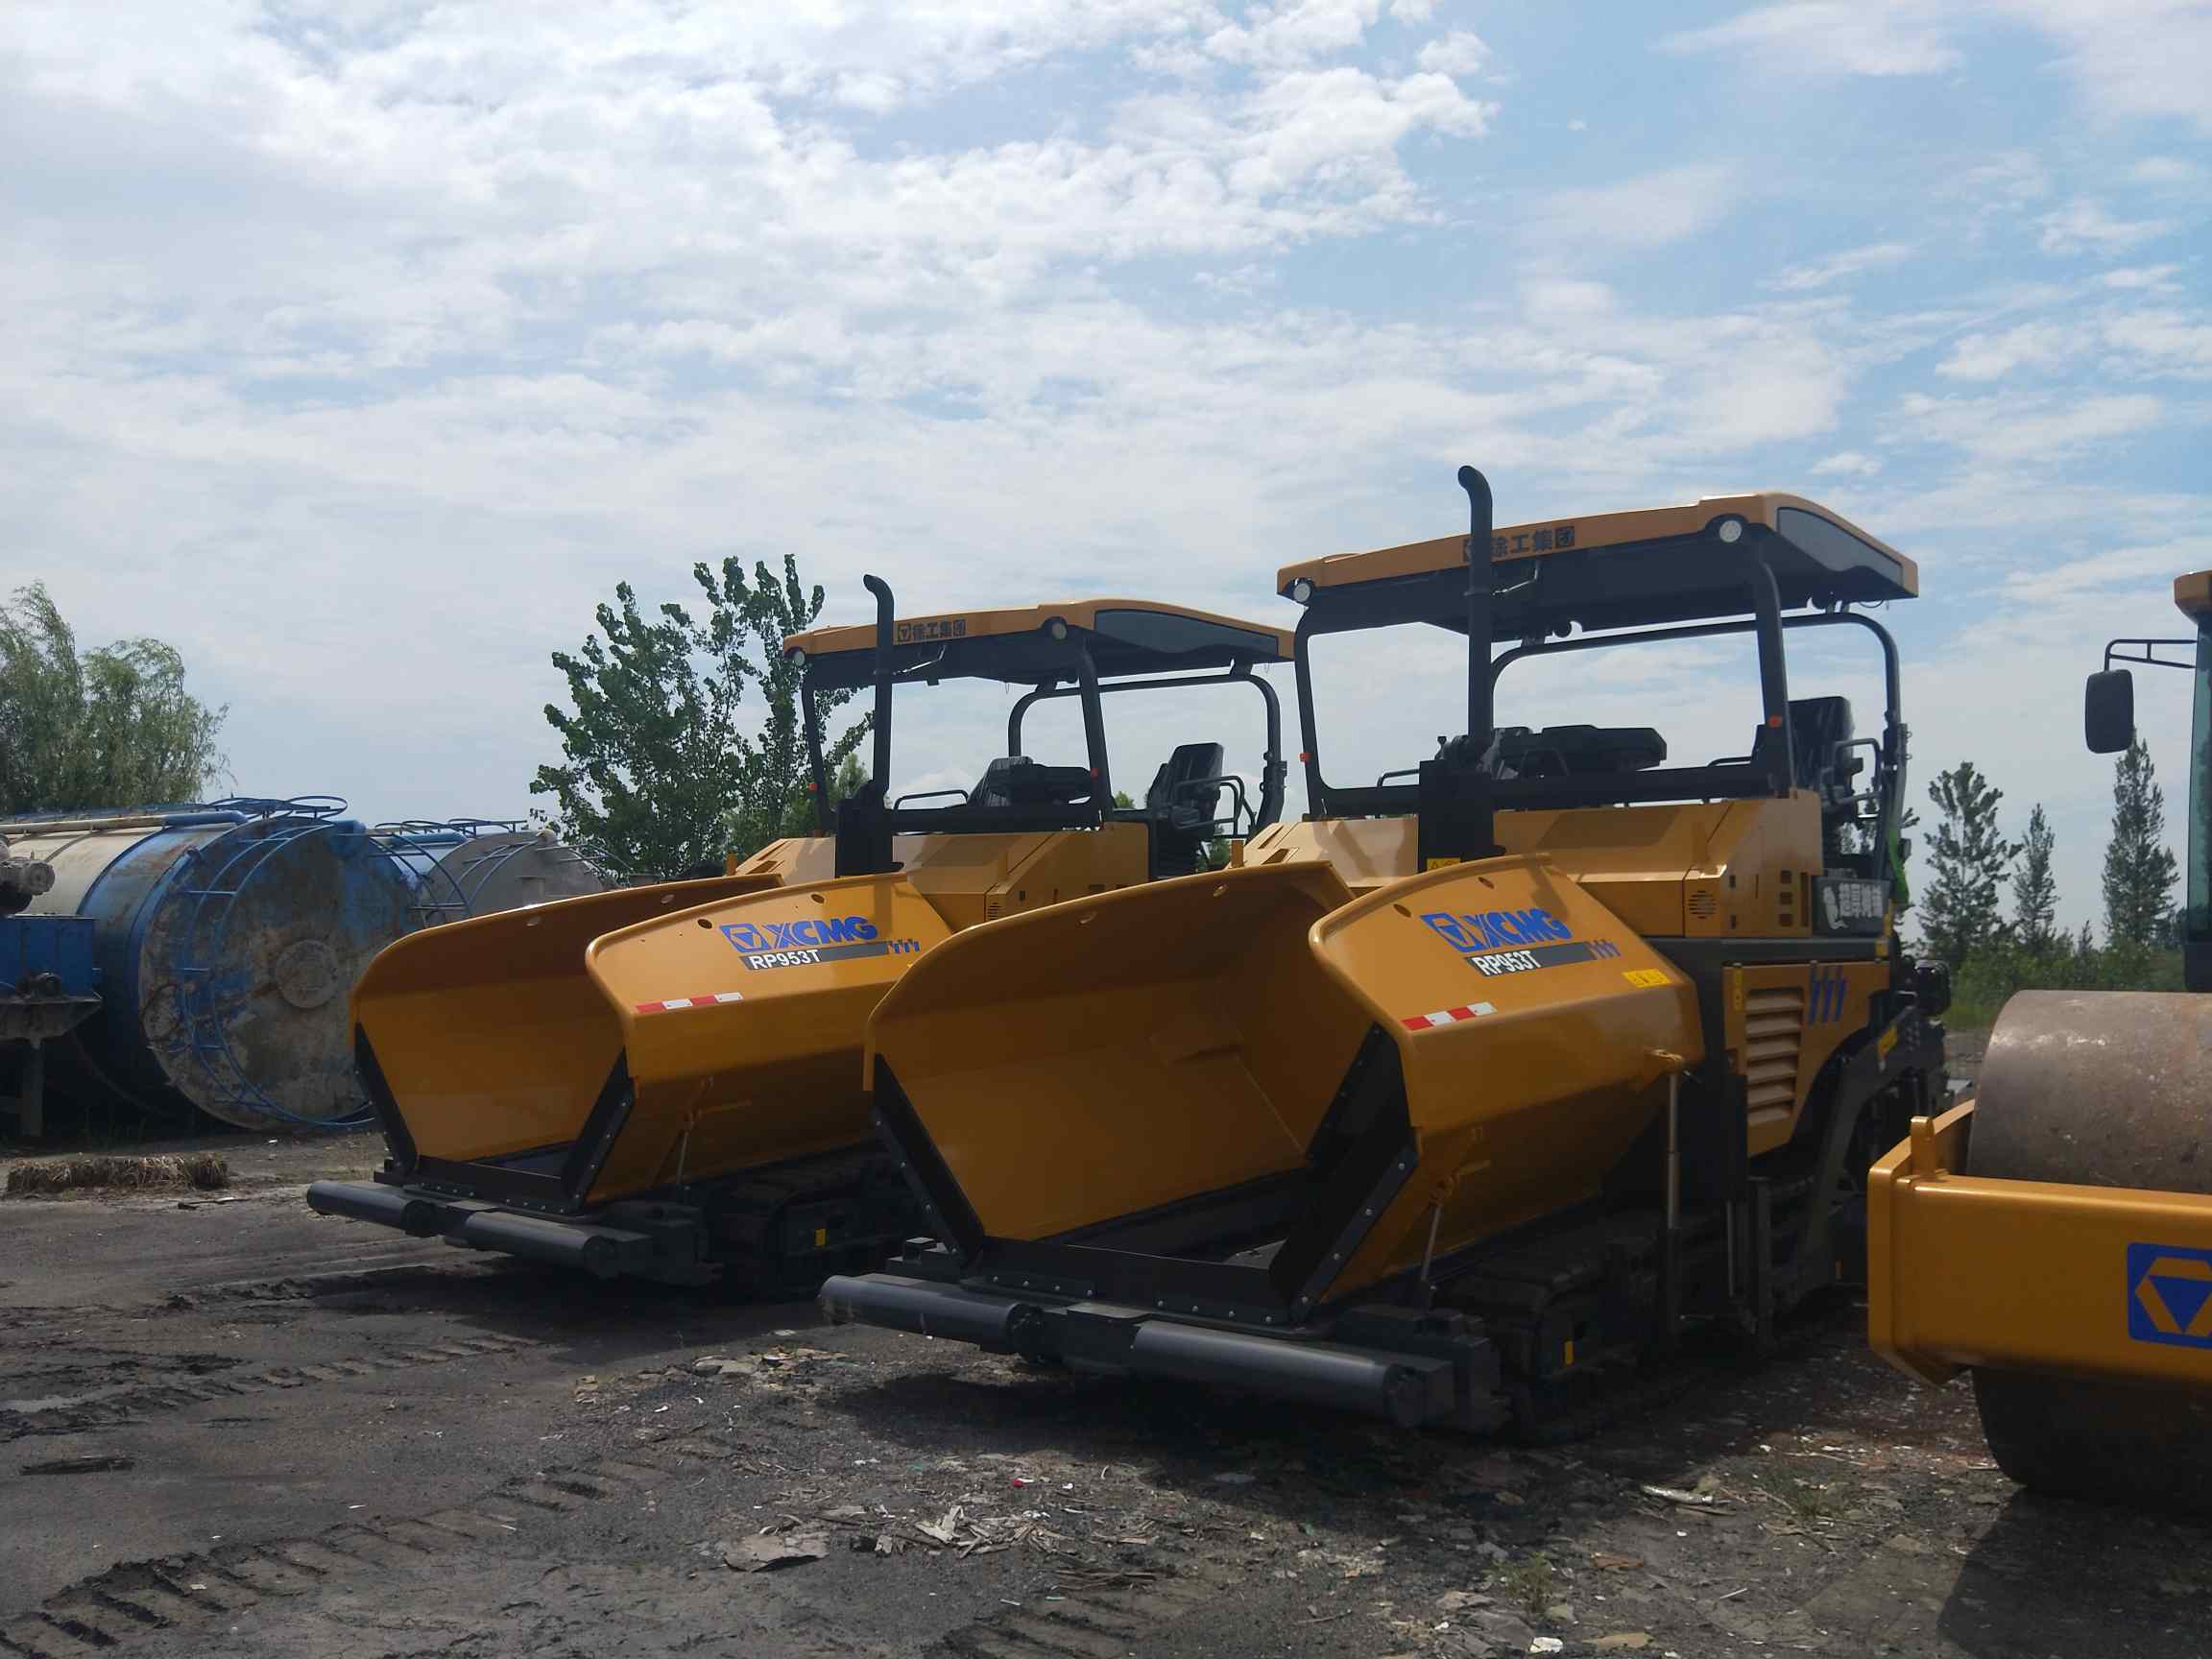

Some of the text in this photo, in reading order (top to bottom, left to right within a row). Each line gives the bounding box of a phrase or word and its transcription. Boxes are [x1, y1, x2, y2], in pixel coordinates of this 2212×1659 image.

[763, 916, 878, 950] XCMG
[1463, 908, 1574, 950] XCMG
[749, 949, 822, 970] RP953T
[1472, 950, 1542, 976] RP953T
